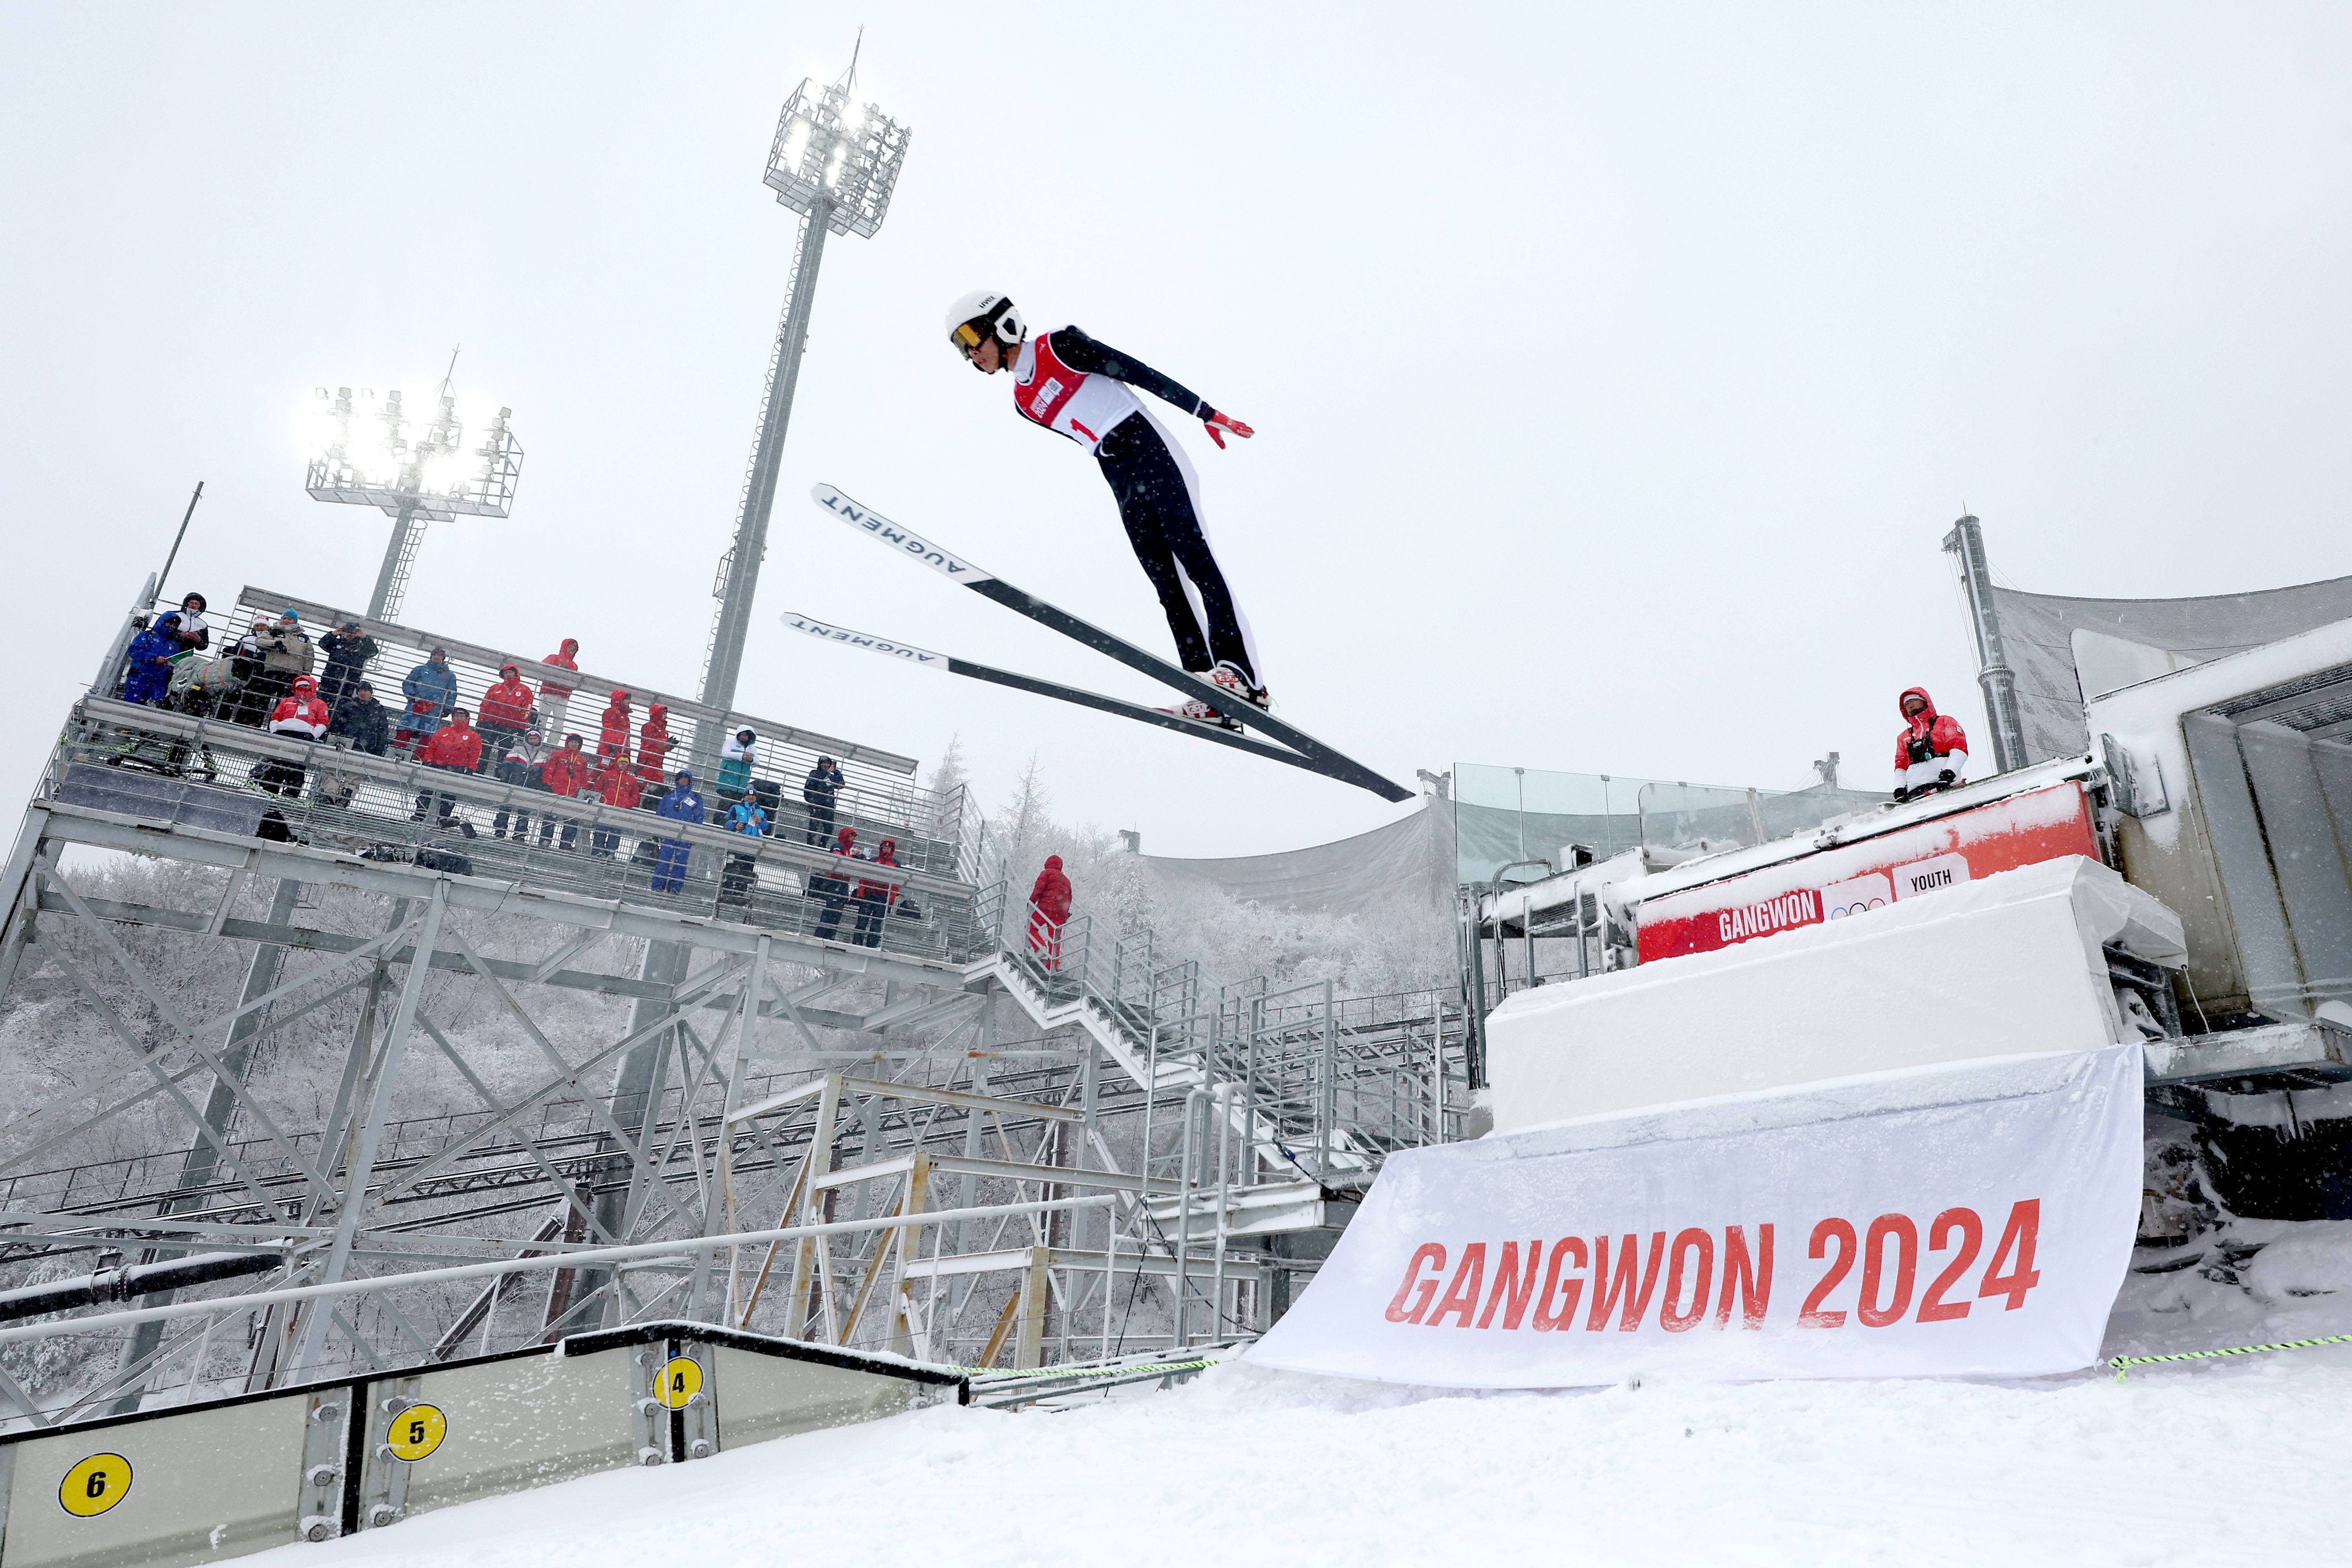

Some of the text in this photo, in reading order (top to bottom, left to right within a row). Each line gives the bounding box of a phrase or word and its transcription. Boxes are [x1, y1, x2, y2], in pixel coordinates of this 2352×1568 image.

[1070, 418, 1099, 442] 1
[822, 496, 967, 573] AUGMENT
[790, 620, 935, 661] AUGMENT
[1911, 869, 1952, 892] YOUTH
[1718, 890, 1816, 942] GANGWON
[1385, 1198, 2041, 1332] GANGWON 2024
[672, 1372, 685, 1393] 4
[409, 1421, 425, 1444] 5
[86, 1471, 106, 1498] 6
